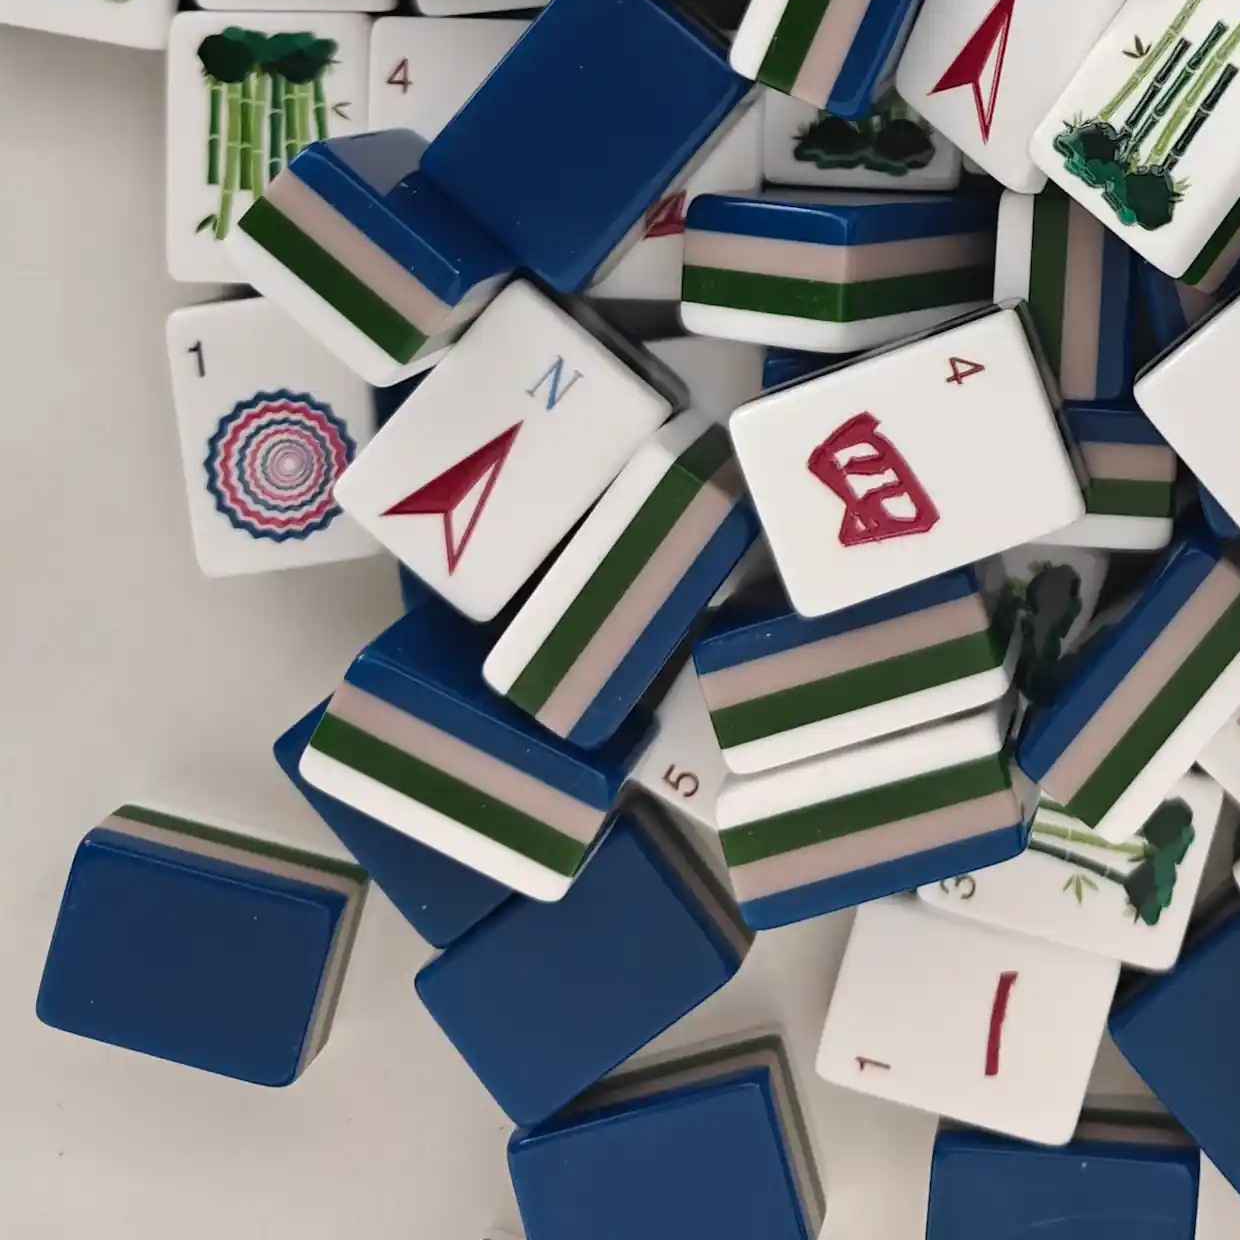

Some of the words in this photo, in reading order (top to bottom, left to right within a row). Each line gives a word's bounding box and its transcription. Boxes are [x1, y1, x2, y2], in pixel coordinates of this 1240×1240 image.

[385, 56, 413, 95] 4
[187, 340, 205, 378] 1
[945, 357, 985, 385] 4
[524, 354, 585, 412] N
[661, 764, 700, 798] 5
[855, 1056, 891, 1071] 1
